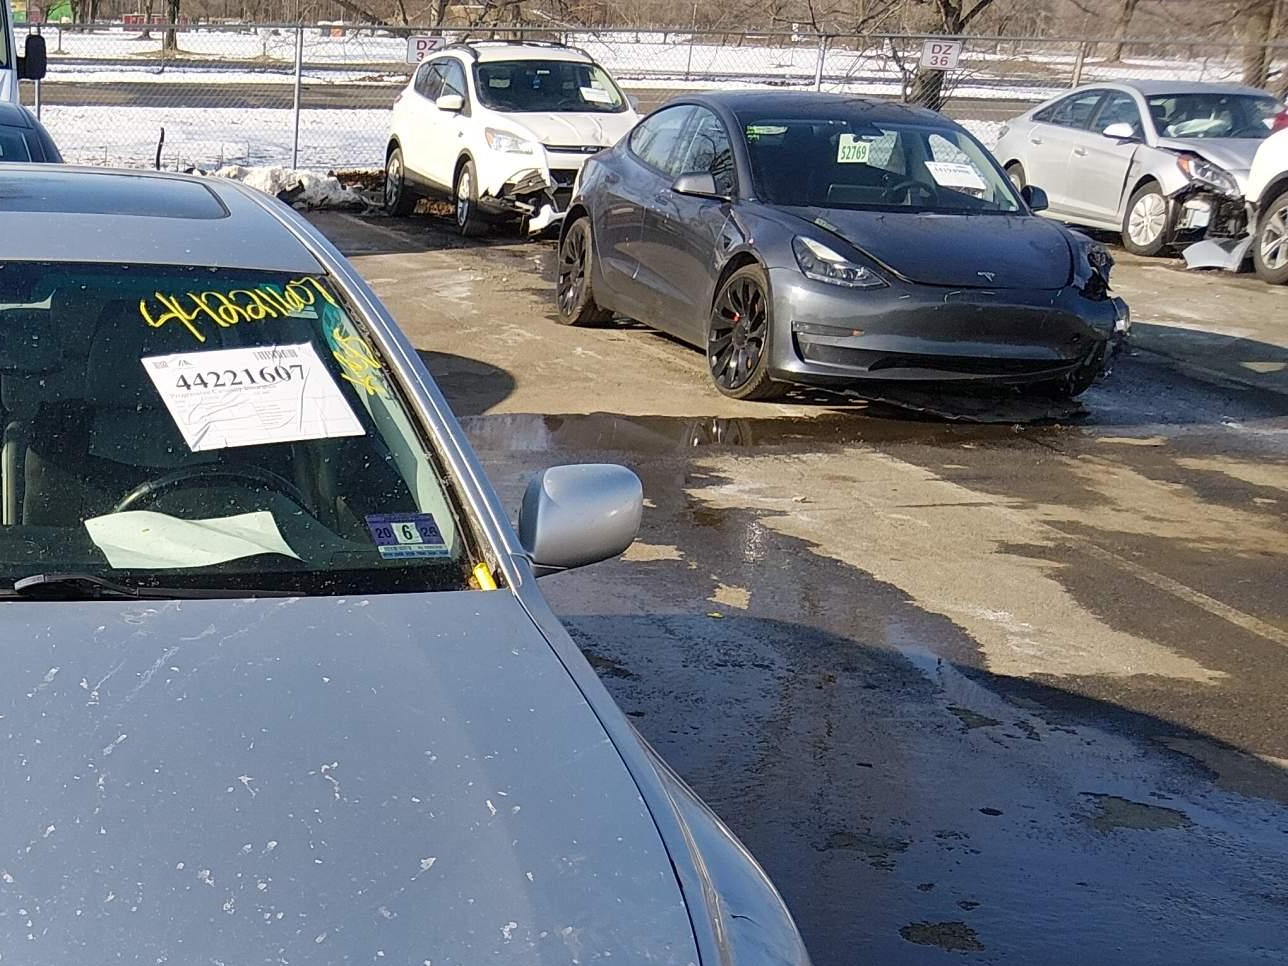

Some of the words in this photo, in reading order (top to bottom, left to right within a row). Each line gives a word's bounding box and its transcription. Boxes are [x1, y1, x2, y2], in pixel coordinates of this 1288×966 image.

[416, 40, 439, 51] DZ
[931, 44, 953, 55] DZ
[416, 51, 425, 62] 3
[930, 55, 949, 66] 36
[840, 144, 867, 160] 52769
[175, 363, 305, 391] 44221607
[375, 527, 392, 539] 20
[401, 523, 414, 541] 6
